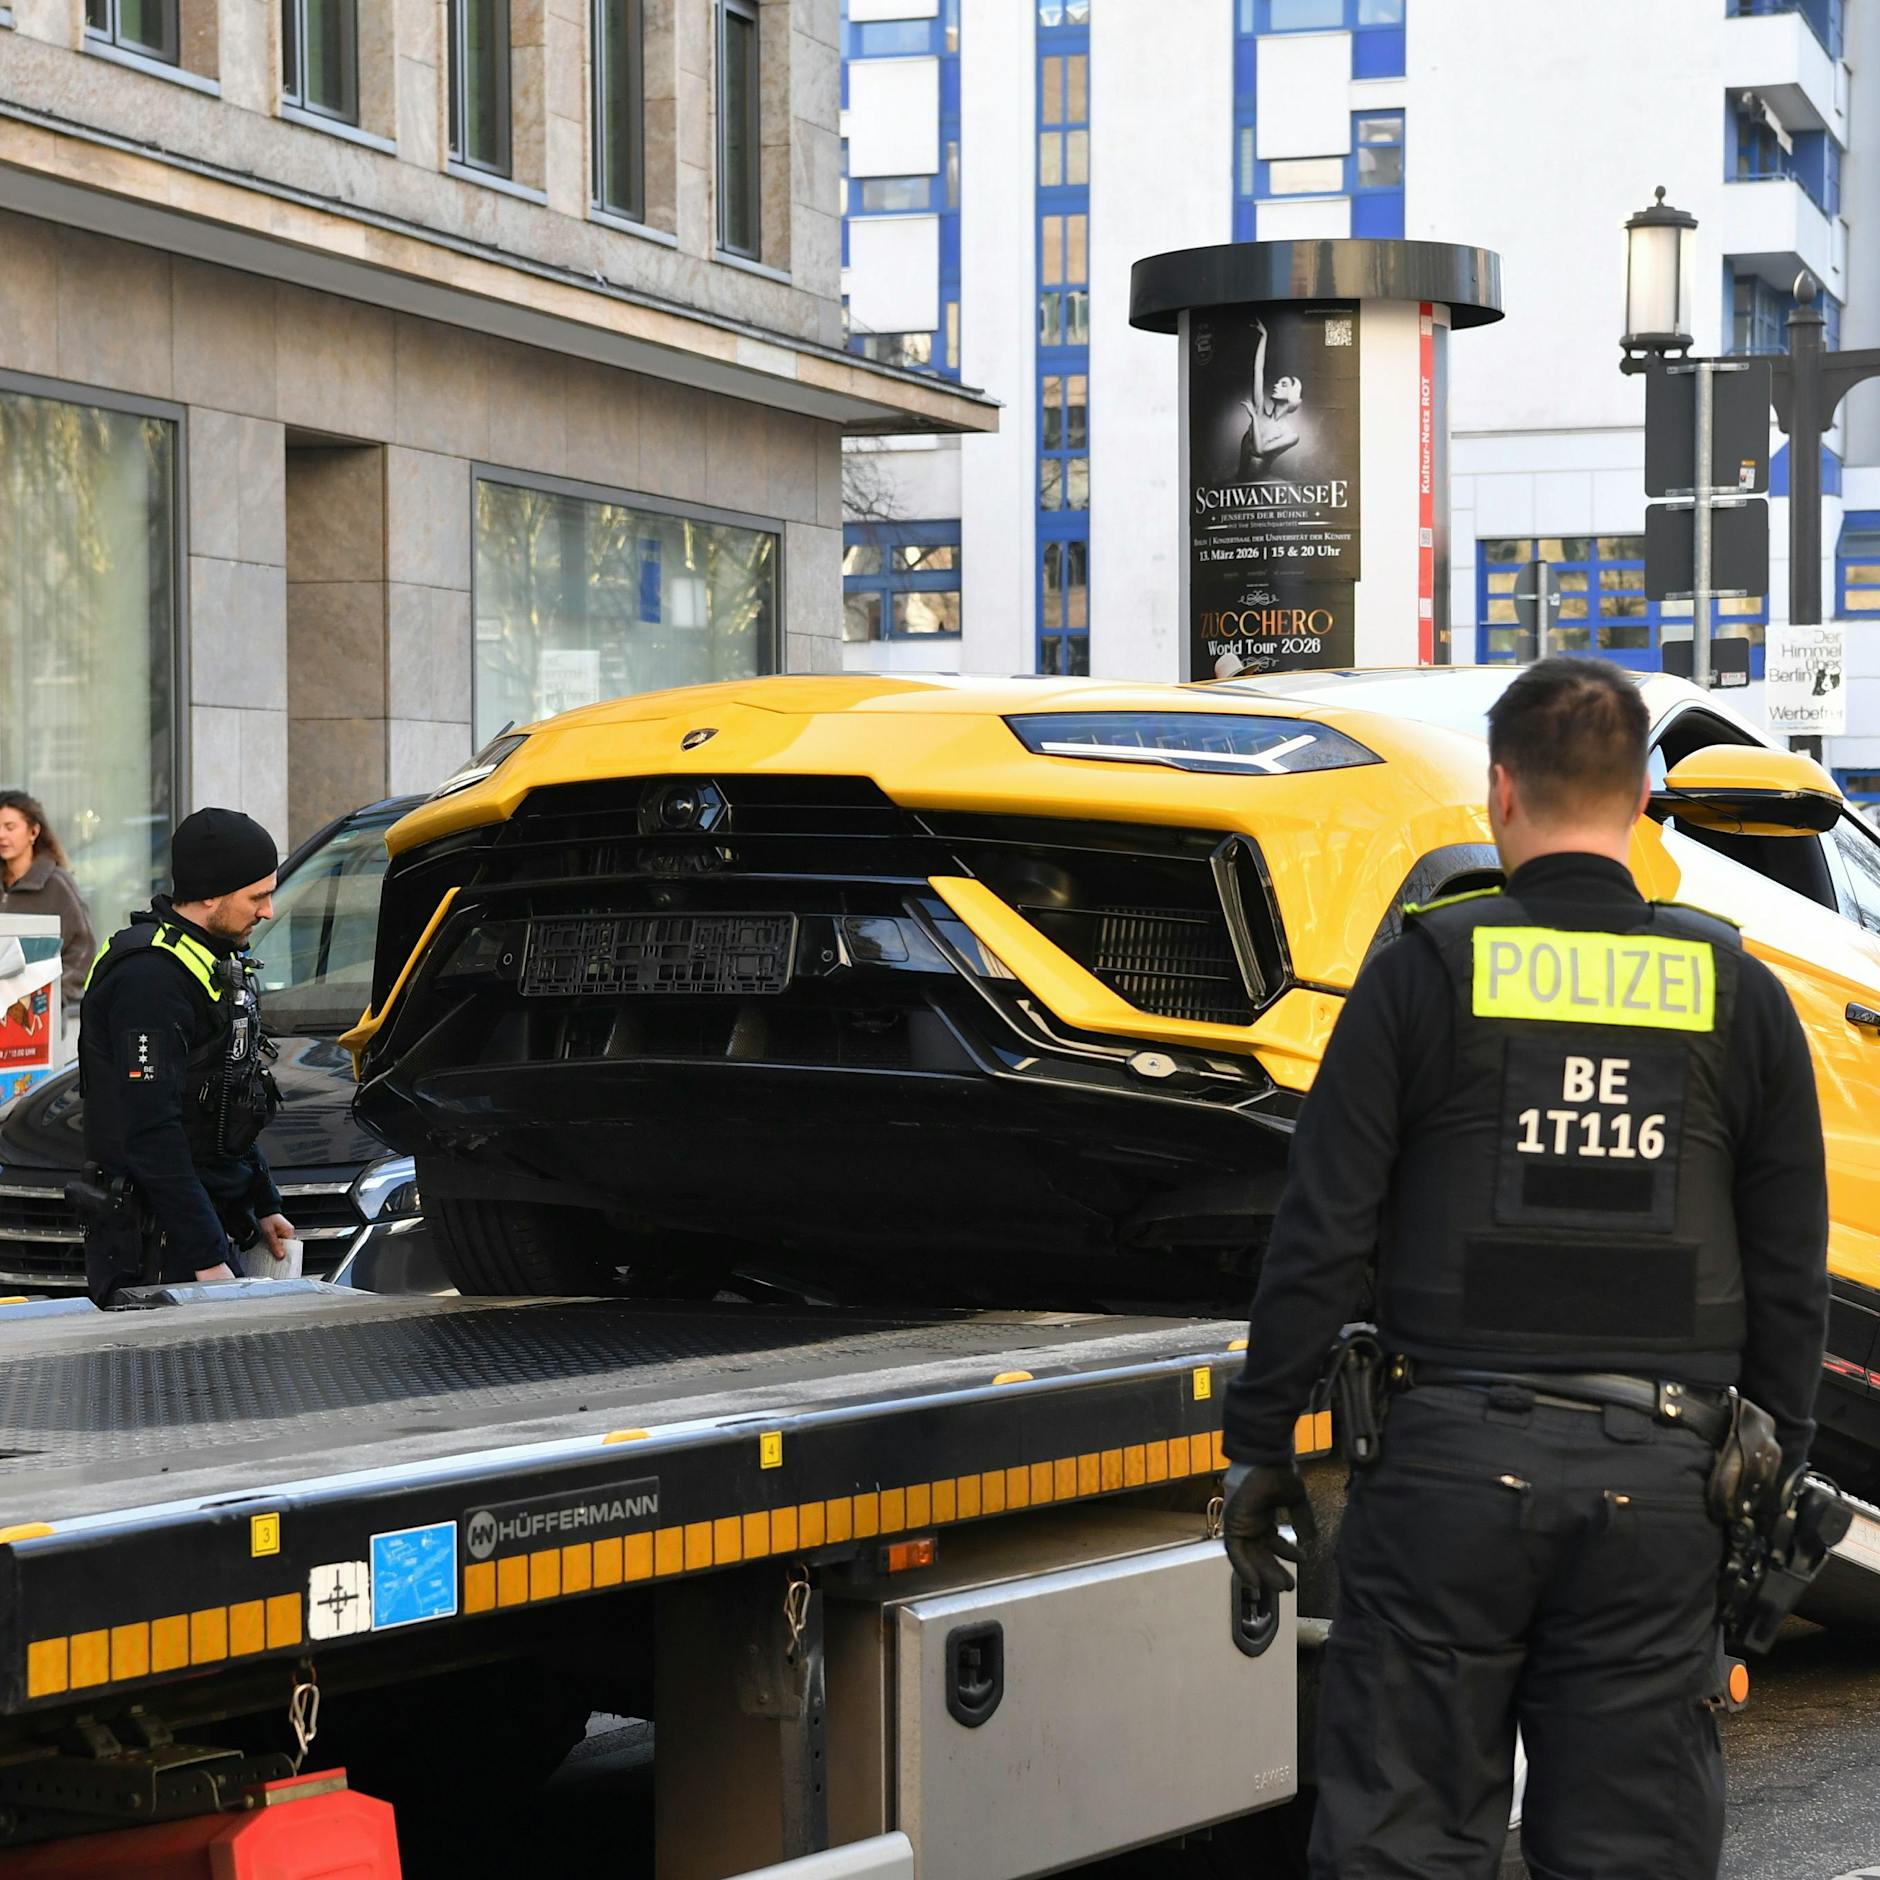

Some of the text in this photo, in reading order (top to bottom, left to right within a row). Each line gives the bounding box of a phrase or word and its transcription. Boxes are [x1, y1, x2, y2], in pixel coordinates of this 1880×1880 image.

[1421, 376, 1430, 494] Kultur-Netz ROT
[1196, 480, 1348, 514] SCHWANENSEE
[1220, 510, 1308, 523] JENSEITS DER BÜHNE
[1199, 545, 1341, 562] 13. März 2026 15 & 20 Uhr
[1200, 608, 1334, 638] ZUCCHERO
[1208, 638, 1322, 656] World Tour 2026
[1814, 630, 1841, 644] Der
[1782, 644, 1842, 658] Himmel
[1769, 668, 1812, 683] Berlin
[1488, 940, 1702, 1015] POLIZEI
[1562, 1056, 1630, 1104] BE
[1516, 1108, 1666, 1160] 1T116
[498, 1494, 658, 1542] HÜFFERMANN
[263, 1526, 270, 1543] 3
